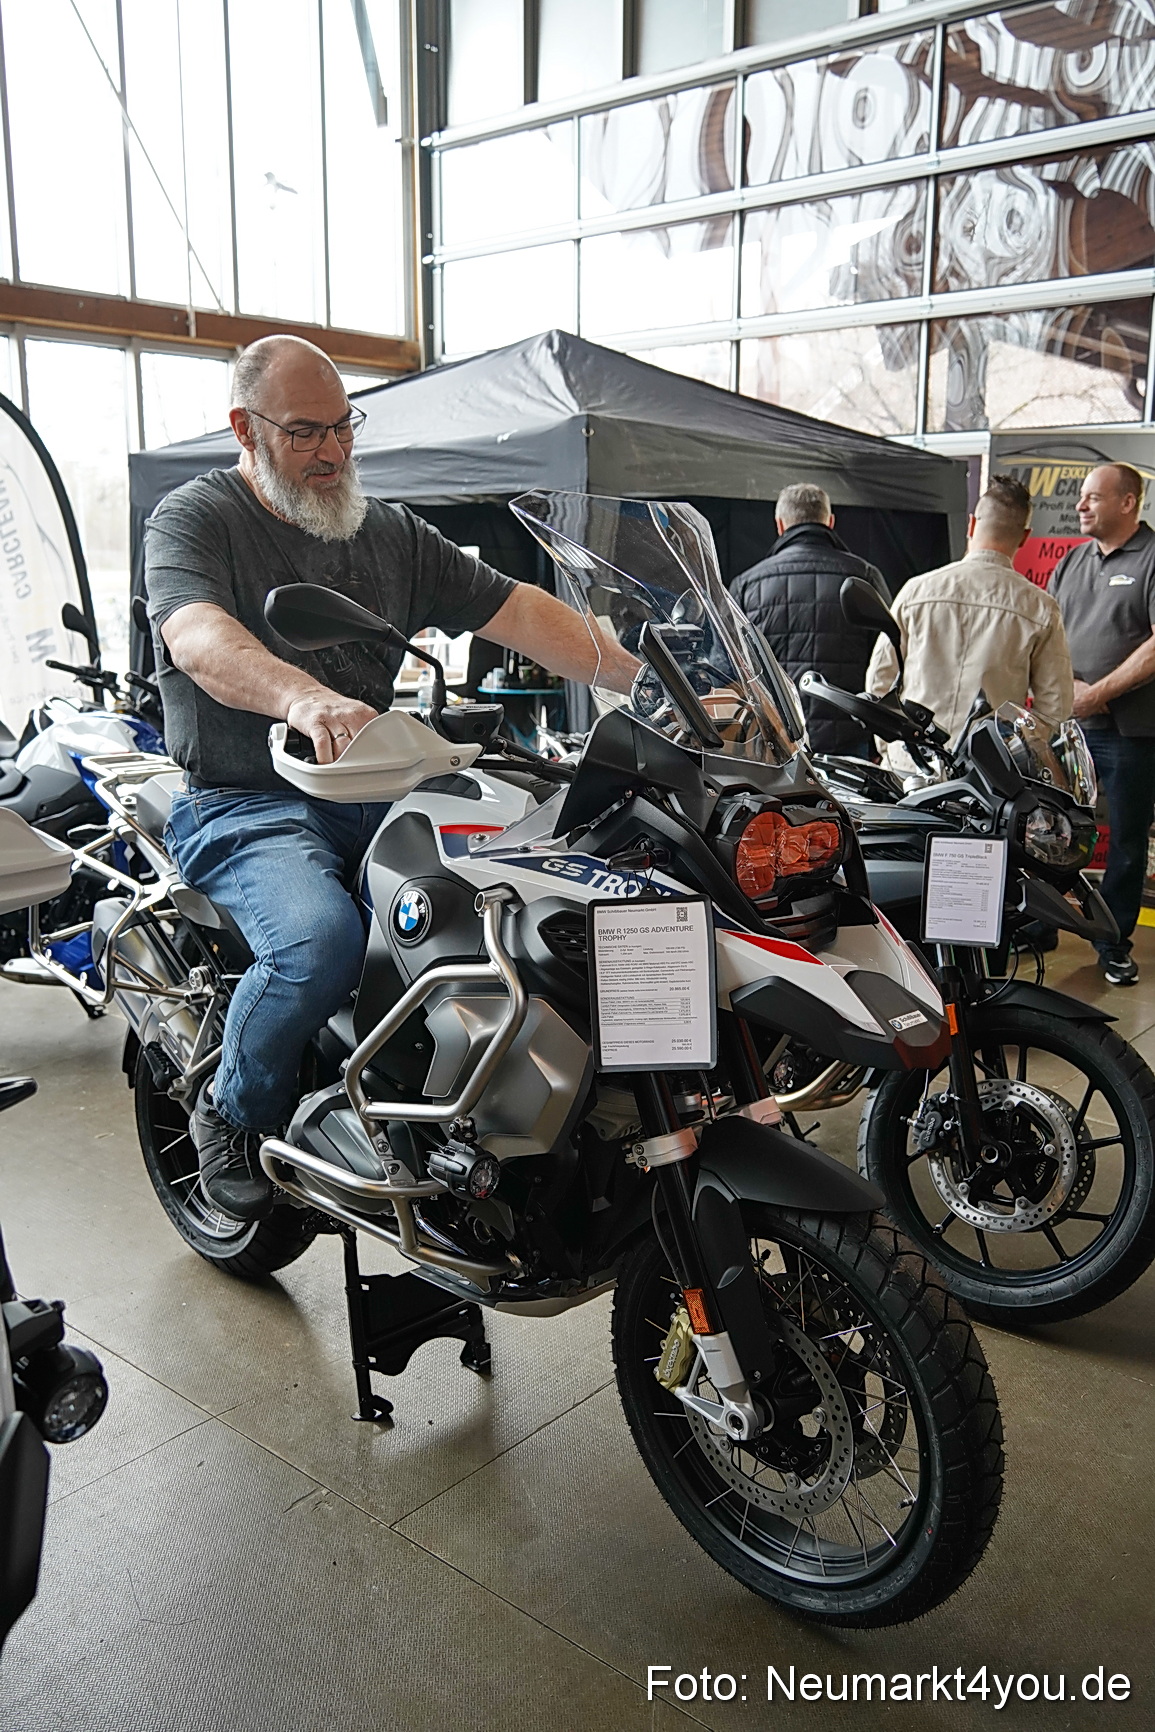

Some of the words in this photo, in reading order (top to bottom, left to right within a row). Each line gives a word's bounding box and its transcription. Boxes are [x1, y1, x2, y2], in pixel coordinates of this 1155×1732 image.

[1056, 479, 1084, 497] CA
[1039, 502, 1064, 511] Profi
[1060, 513, 1081, 522] Mot
[1048, 525, 1081, 535] Aufbe
[1025, 568, 1055, 590] Auf
[541, 858, 589, 878] GS
[598, 928, 616, 936] BMW
[623, 927, 638, 935] 1250
[639, 926, 650, 934] GS
[651, 925, 694, 934] ADVENTURE
[598, 934, 627, 942] TROPHY
